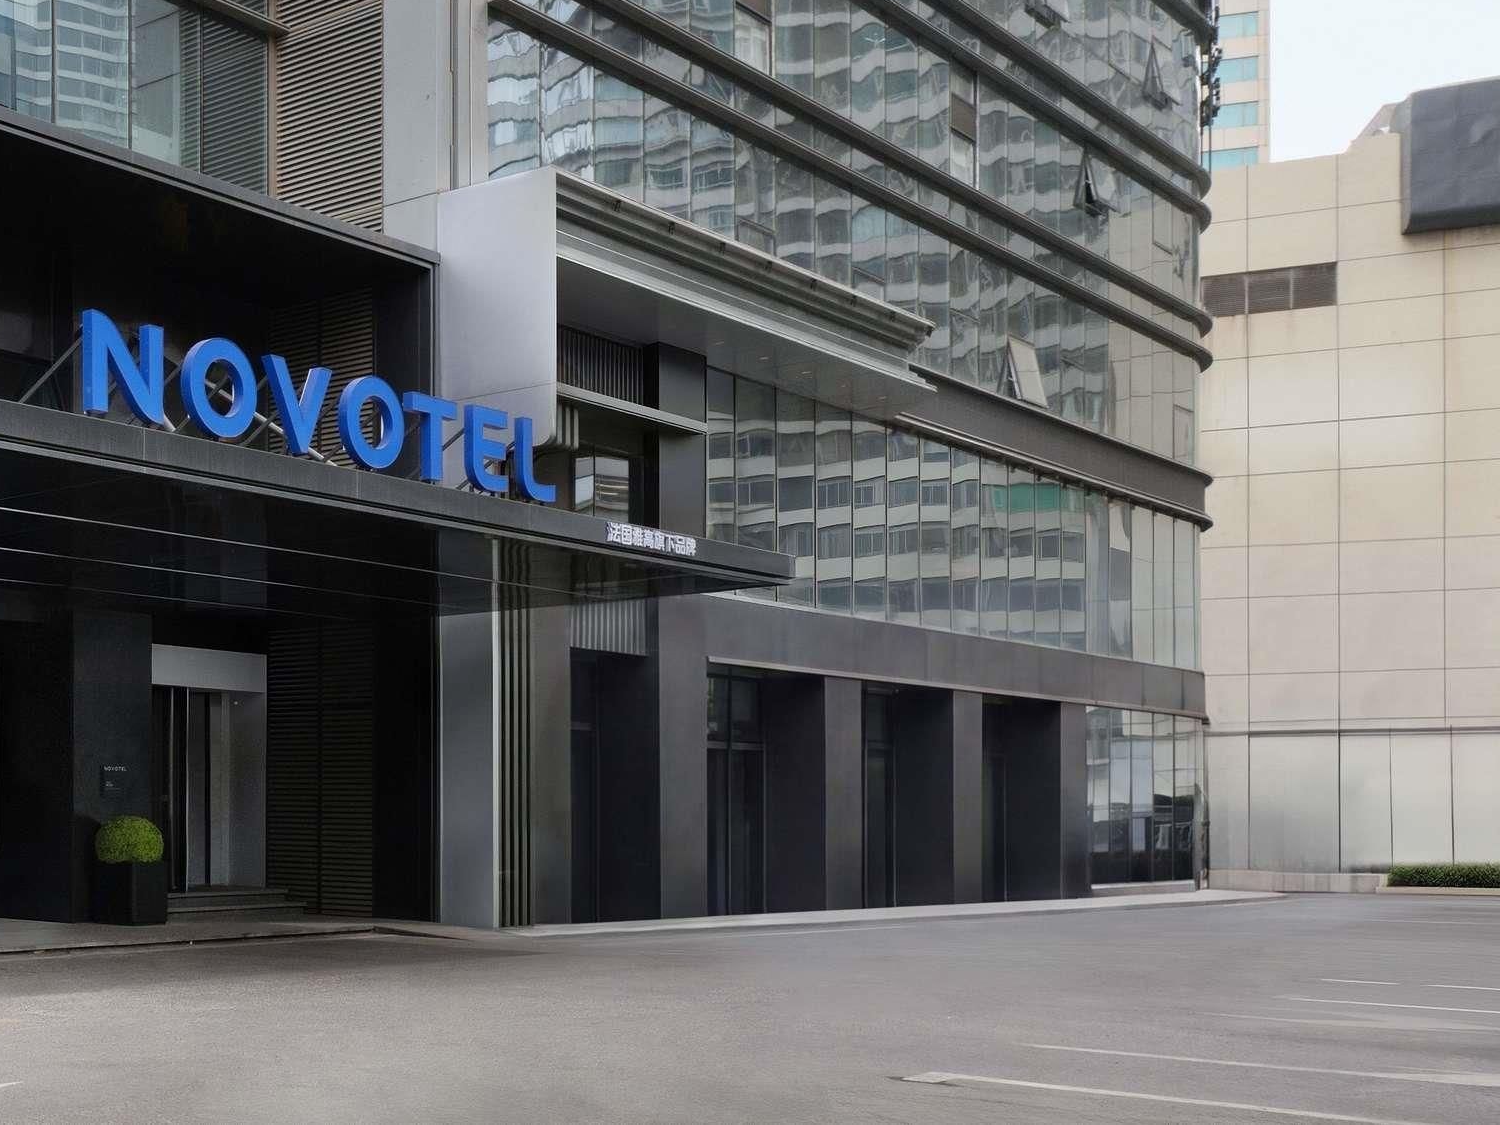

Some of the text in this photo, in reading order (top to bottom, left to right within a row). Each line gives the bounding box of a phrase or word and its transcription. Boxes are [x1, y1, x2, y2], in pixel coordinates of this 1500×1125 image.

[81, 308, 556, 503] NOVOTEL
[606, 521, 697, 556] 法国雅高旗下品牌
